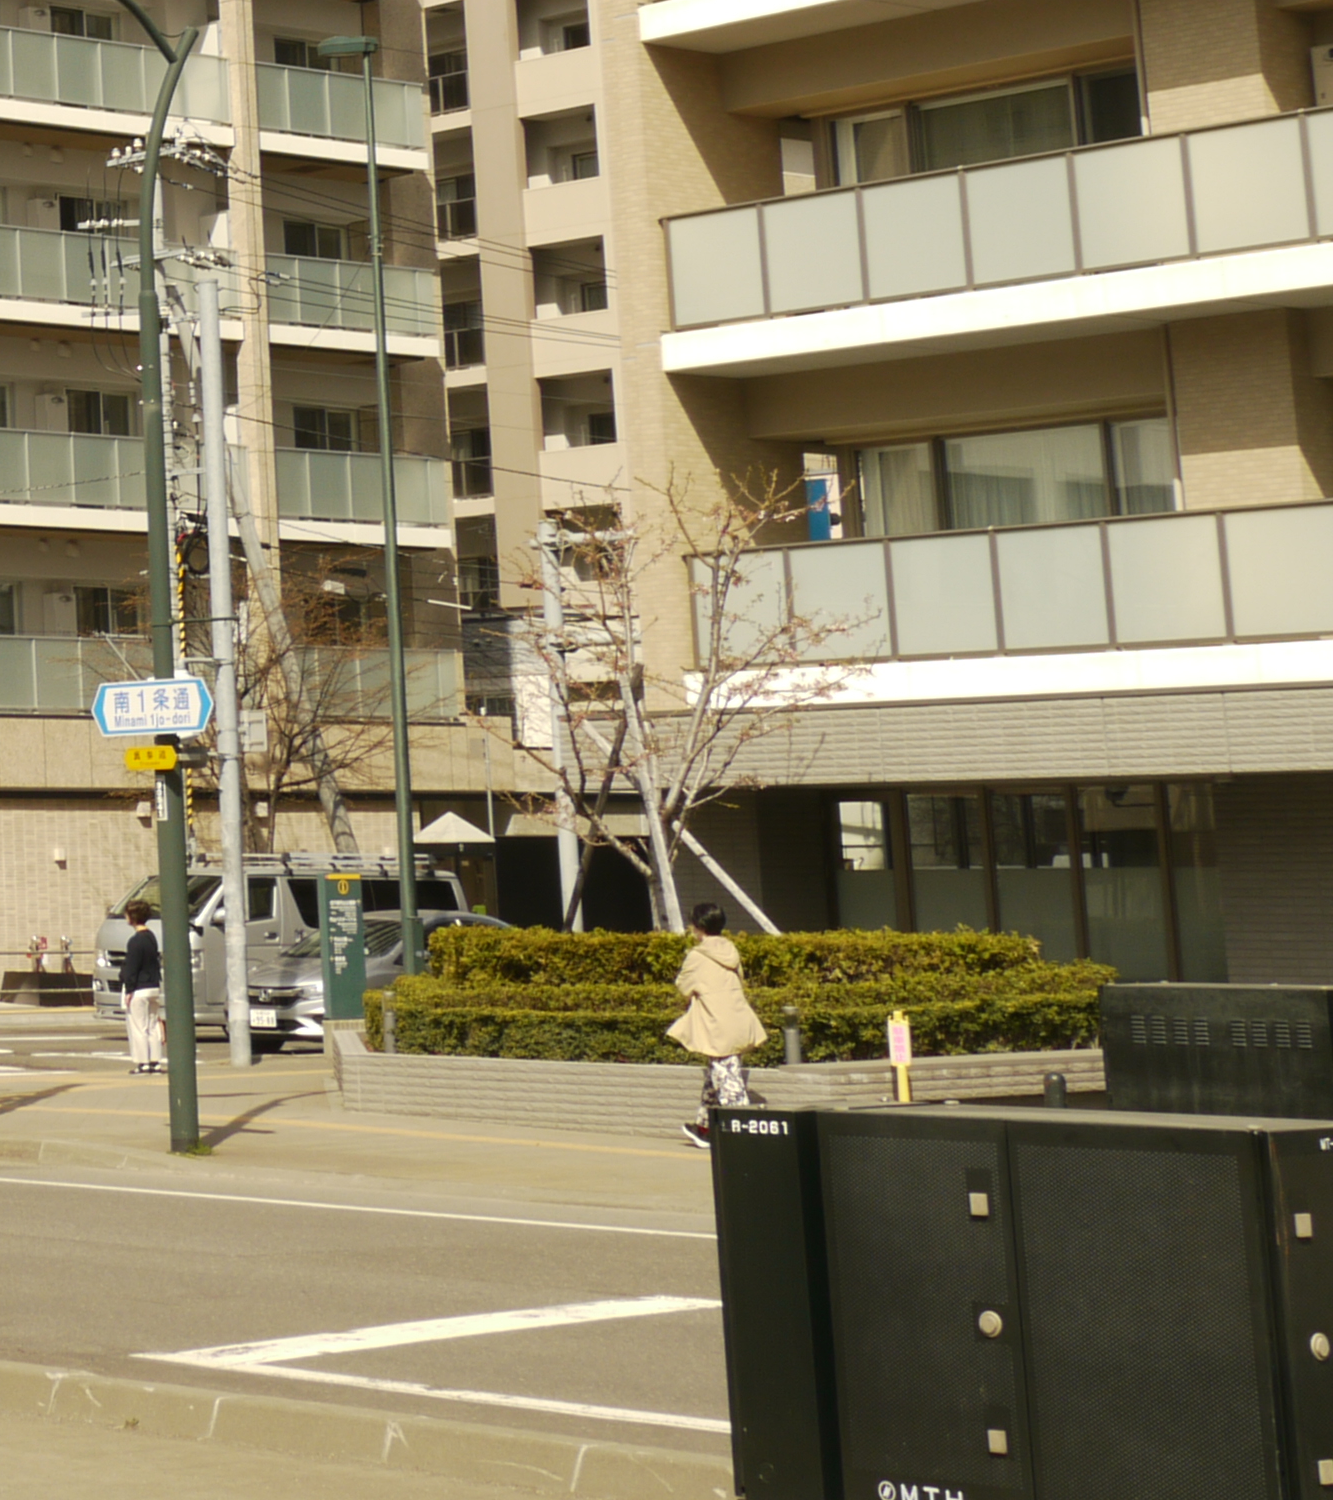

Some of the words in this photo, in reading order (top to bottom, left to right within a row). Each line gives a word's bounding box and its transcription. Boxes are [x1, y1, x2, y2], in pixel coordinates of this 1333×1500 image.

[113, 688, 190, 713] 南1条通
[115, 714, 147, 727] Minami
